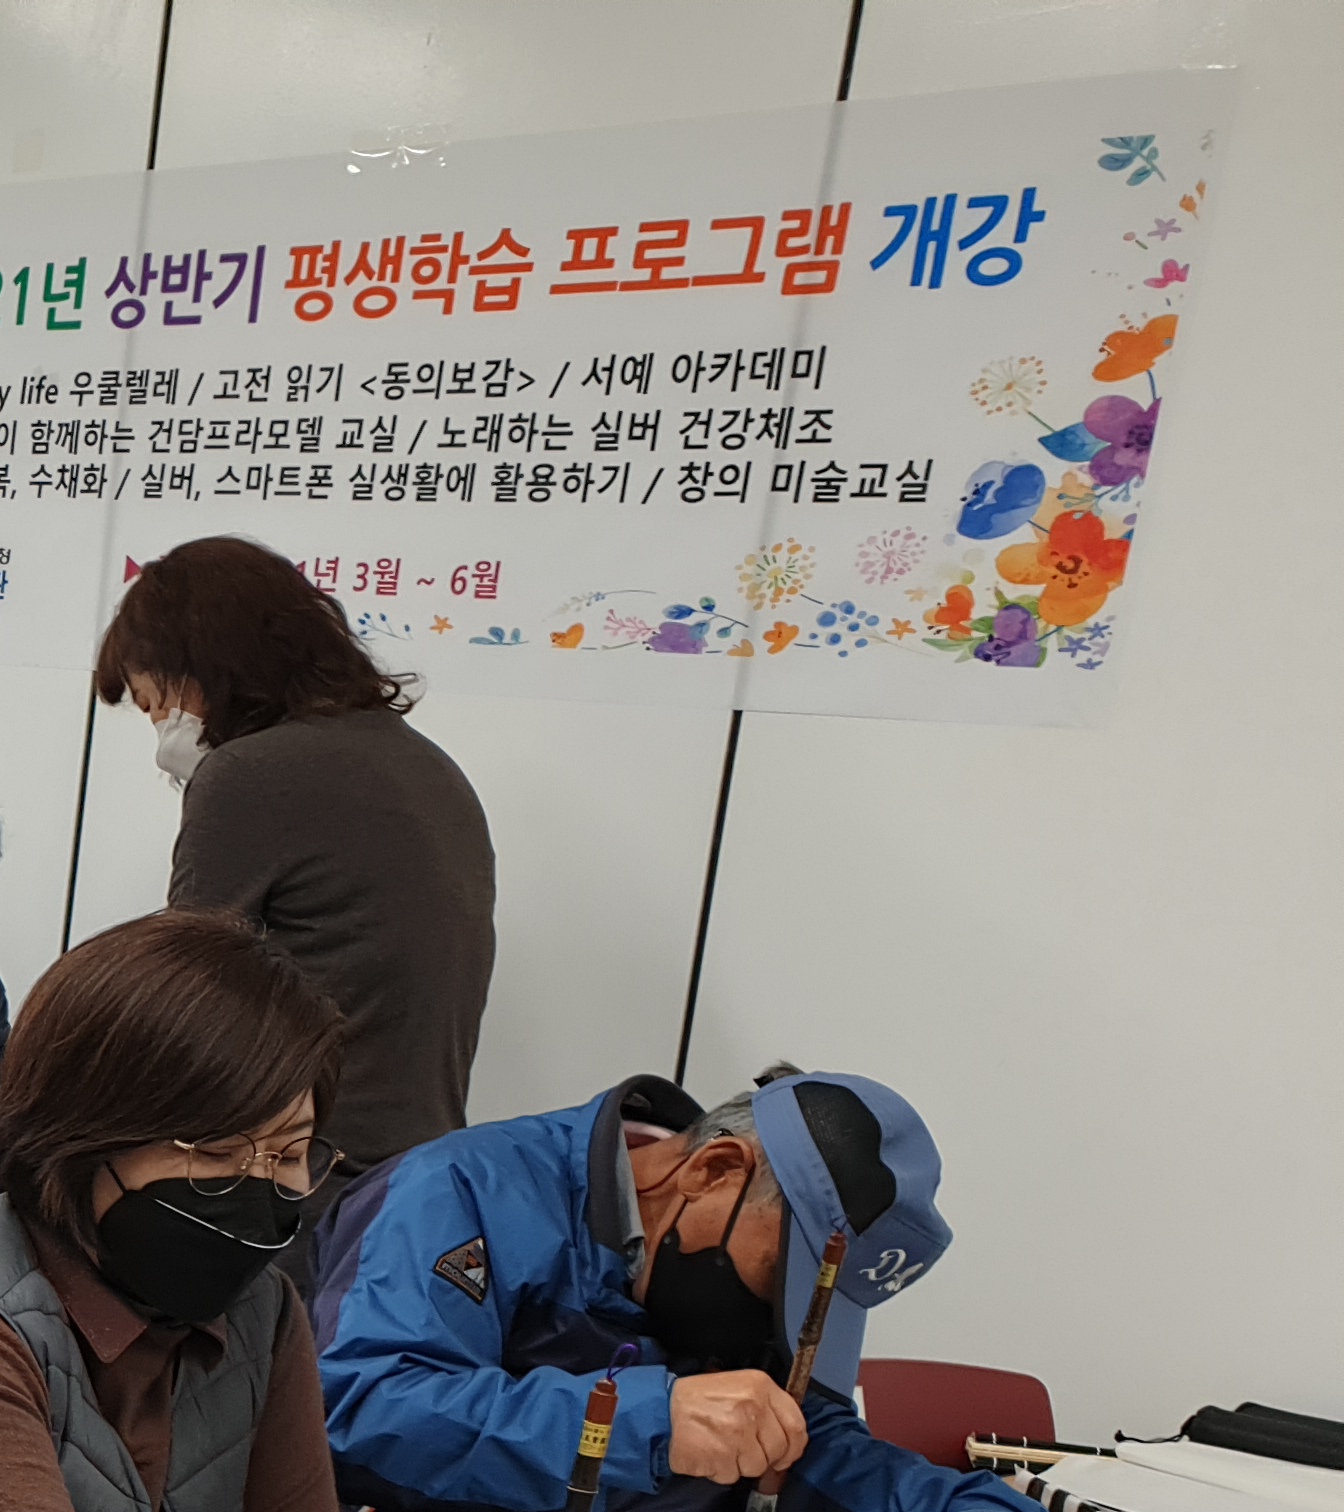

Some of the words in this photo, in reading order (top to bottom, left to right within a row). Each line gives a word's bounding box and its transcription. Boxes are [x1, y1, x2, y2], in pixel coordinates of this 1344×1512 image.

[104, 244, 267, 330] 상반기
[284, 227, 535, 323] 평생학습
[549, 201, 852, 297] 프로그램
[869, 186, 1047, 290] 개강
[19, 375, 59, 405] life
[69, 368, 180, 407] 우쿨렐레
[187, 372, 205, 407] /
[212, 364, 272, 403] 고전
[286, 362, 344, 403] 읽기
[360, 357, 536, 401] <동의보감>
[548, 361, 571, 399] /
[580, 352, 655, 396] 서예
[671, 345, 827, 394] 아카데미
[30, 418, 136, 456] 함께하는
[147, 415, 324, 455] 건담프라모델
[335, 414, 398, 454] 교실
[407, 419, 428, 456] /
[436, 411, 574, 453] 노래하는
[590, 409, 662, 452] 실버
[678, 405, 834, 451] 건강체조
[28, 463, 108, 499] 수채화
[113, 468, 132, 501] /
[140, 463, 201, 502] 실버,
[213, 463, 334, 501] 스마트폰
[348, 462, 477, 503] 실생활에
[490, 461, 631, 504] 활용하기
[640, 467, 665, 505] /
[677, 460, 753, 504] 창의
[770, 458, 934, 504] 미술교실
[352, 557, 402, 596] 3월
[416, 577, 435, 586] ~
[450, 560, 502, 600] 6월
